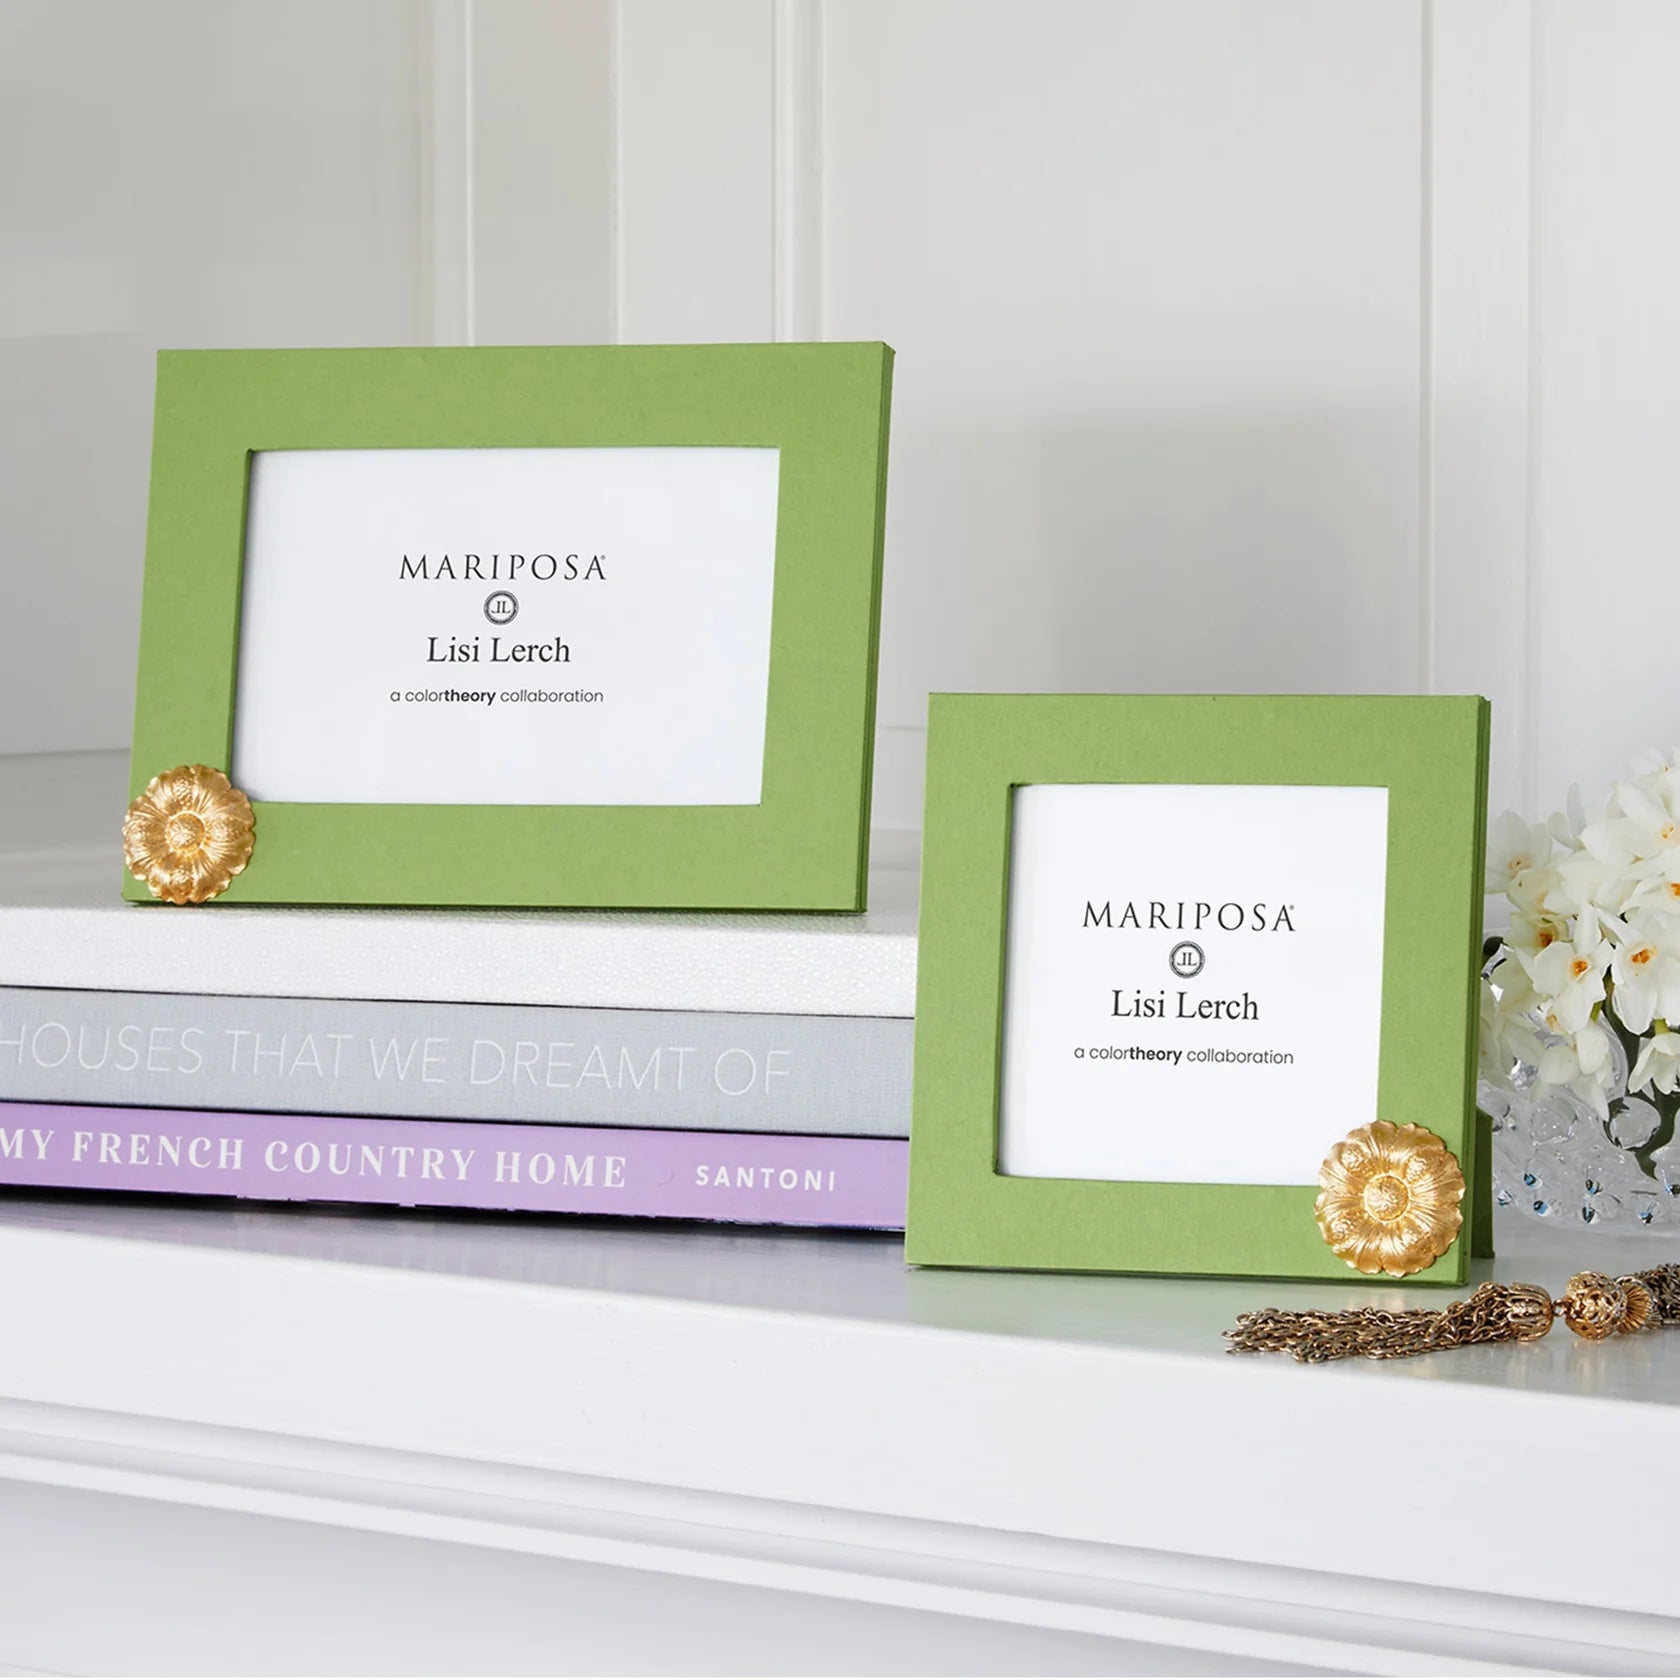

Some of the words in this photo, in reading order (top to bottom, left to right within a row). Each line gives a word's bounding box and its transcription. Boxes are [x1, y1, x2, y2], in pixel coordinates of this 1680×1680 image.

[426, 636, 480, 662] Lisi
[490, 636, 571, 662] Lerch
[390, 691, 400, 702] a
[404, 689, 496, 706] colortheory
[499, 689, 604, 703] collaboration
[1111, 989, 1166, 1018] Lisi
[1176, 991, 1260, 1021] Lerch
[223, 1029, 354, 1079] THAT
[369, 1037, 449, 1084] WE
[469, 1039, 697, 1092] DREAMT
[714, 1047, 792, 1097] OF
[1073, 1047, 1085, 1059] a
[1089, 1046, 1182, 1066] colortheory
[1186, 1048, 1294, 1065] collaboration
[0, 1128, 55, 1160] MY
[71, 1131, 245, 1171] FRENCH
[264, 1140, 476, 1181] COUNTRY
[494, 1151, 627, 1188] HOME
[695, 1164, 836, 1192] SANTONI
